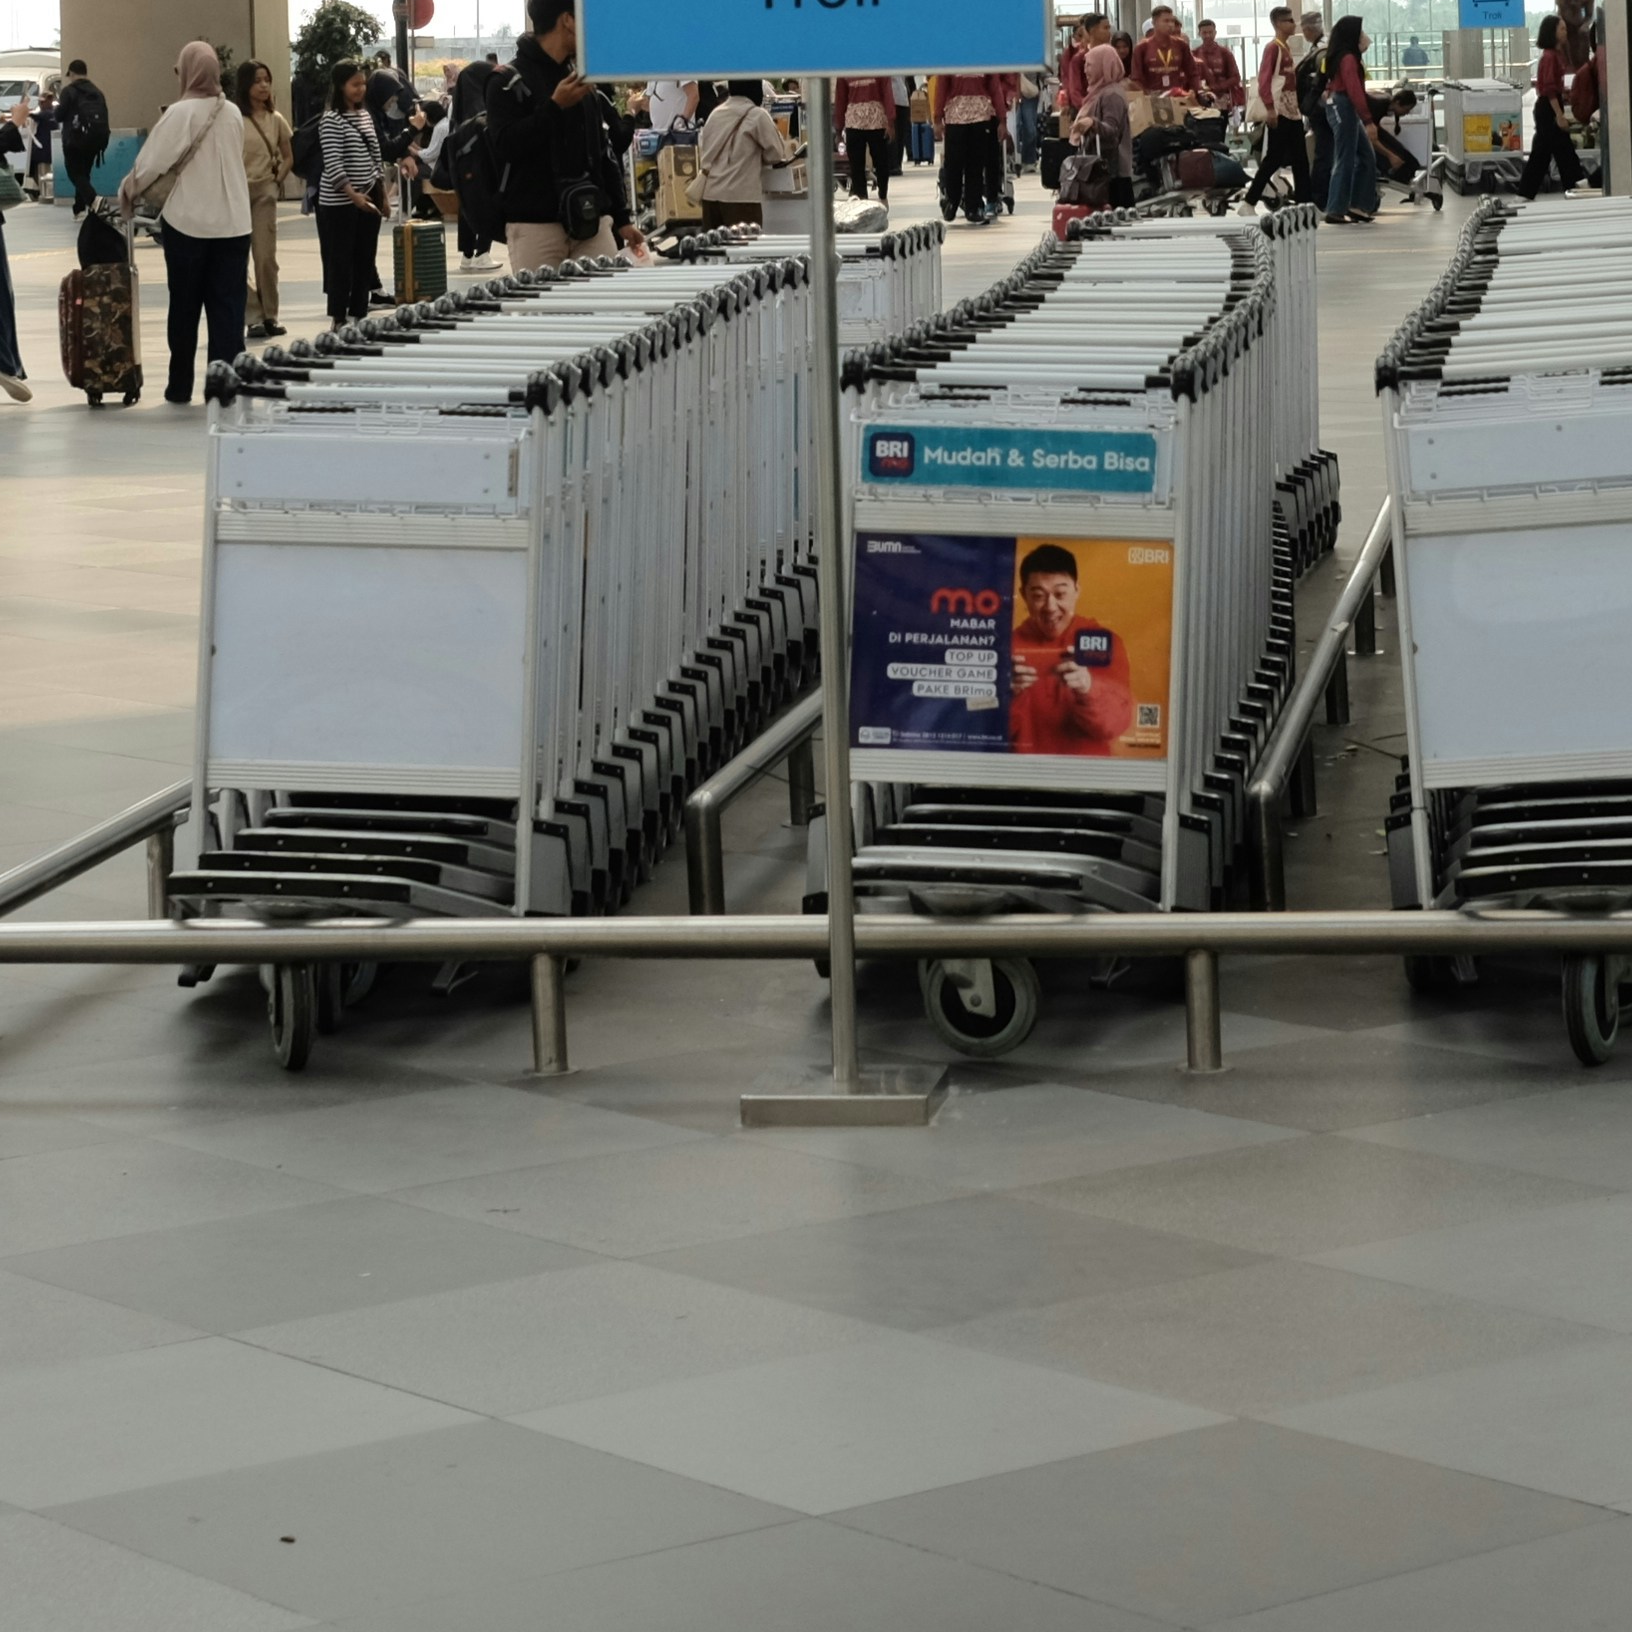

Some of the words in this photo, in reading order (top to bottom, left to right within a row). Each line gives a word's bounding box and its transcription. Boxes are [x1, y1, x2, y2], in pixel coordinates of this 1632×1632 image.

[1482, 11, 1503, 21] Troli
[875, 440, 909, 458] BRI
[923, 446, 1001, 467] Mudah
[1007, 449, 1025, 467] &
[1032, 449, 1097, 469] Serba
[1104, 451, 1150, 471] Bisa
[1145, 548, 1169, 564] BRI
[930, 587, 1001, 616] mo
[950, 618, 996, 630] MABAR
[889, 631, 901, 643] DI
[905, 632, 996, 646] PERJALANAN?
[1079, 635, 1107, 651] BRI
[949, 651, 974, 662] TOP
[977, 652, 995, 663] UP
[891, 666, 952, 678] VOUCHER
[956, 668, 994, 680] GAME
[916, 684, 949, 695] PAKE
[954, 685, 993, 696] BRImo
